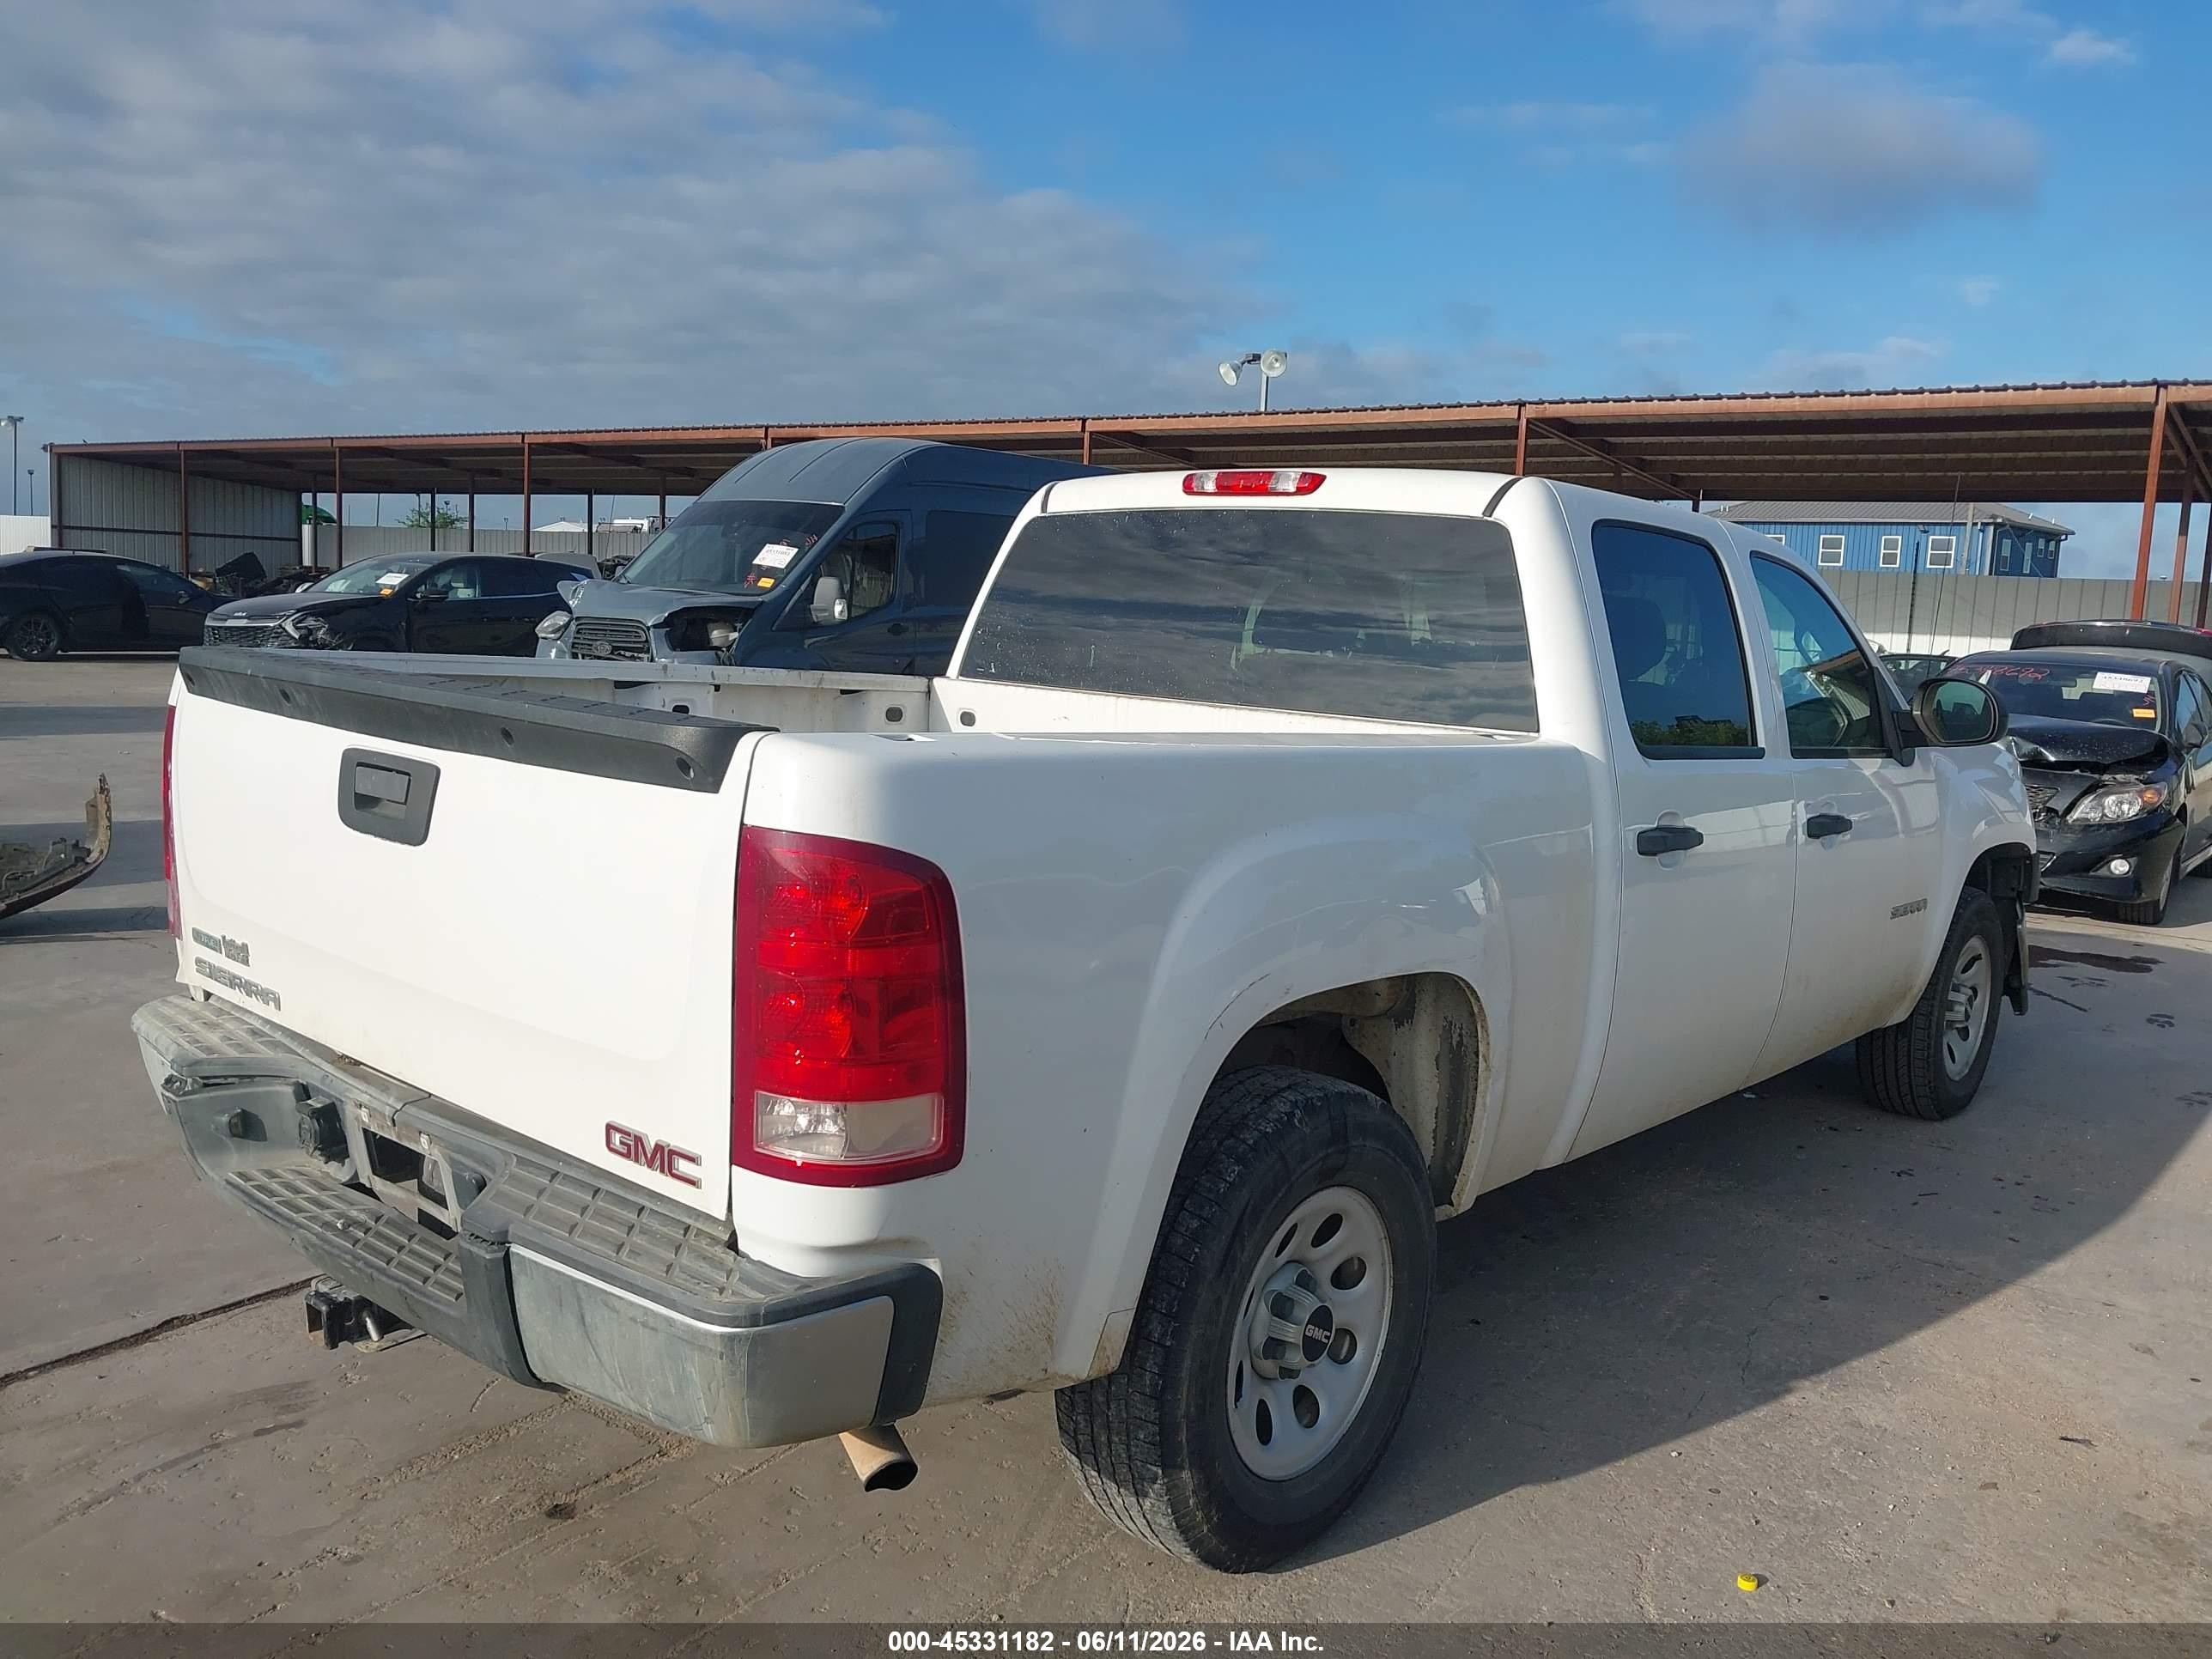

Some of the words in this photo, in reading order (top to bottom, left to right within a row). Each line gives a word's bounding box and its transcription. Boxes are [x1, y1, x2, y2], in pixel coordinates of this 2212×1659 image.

[194, 956, 281, 1012] SIERRA
[605, 1121, 702, 1189] GMC
[1304, 1324, 1331, 1343] GMC
